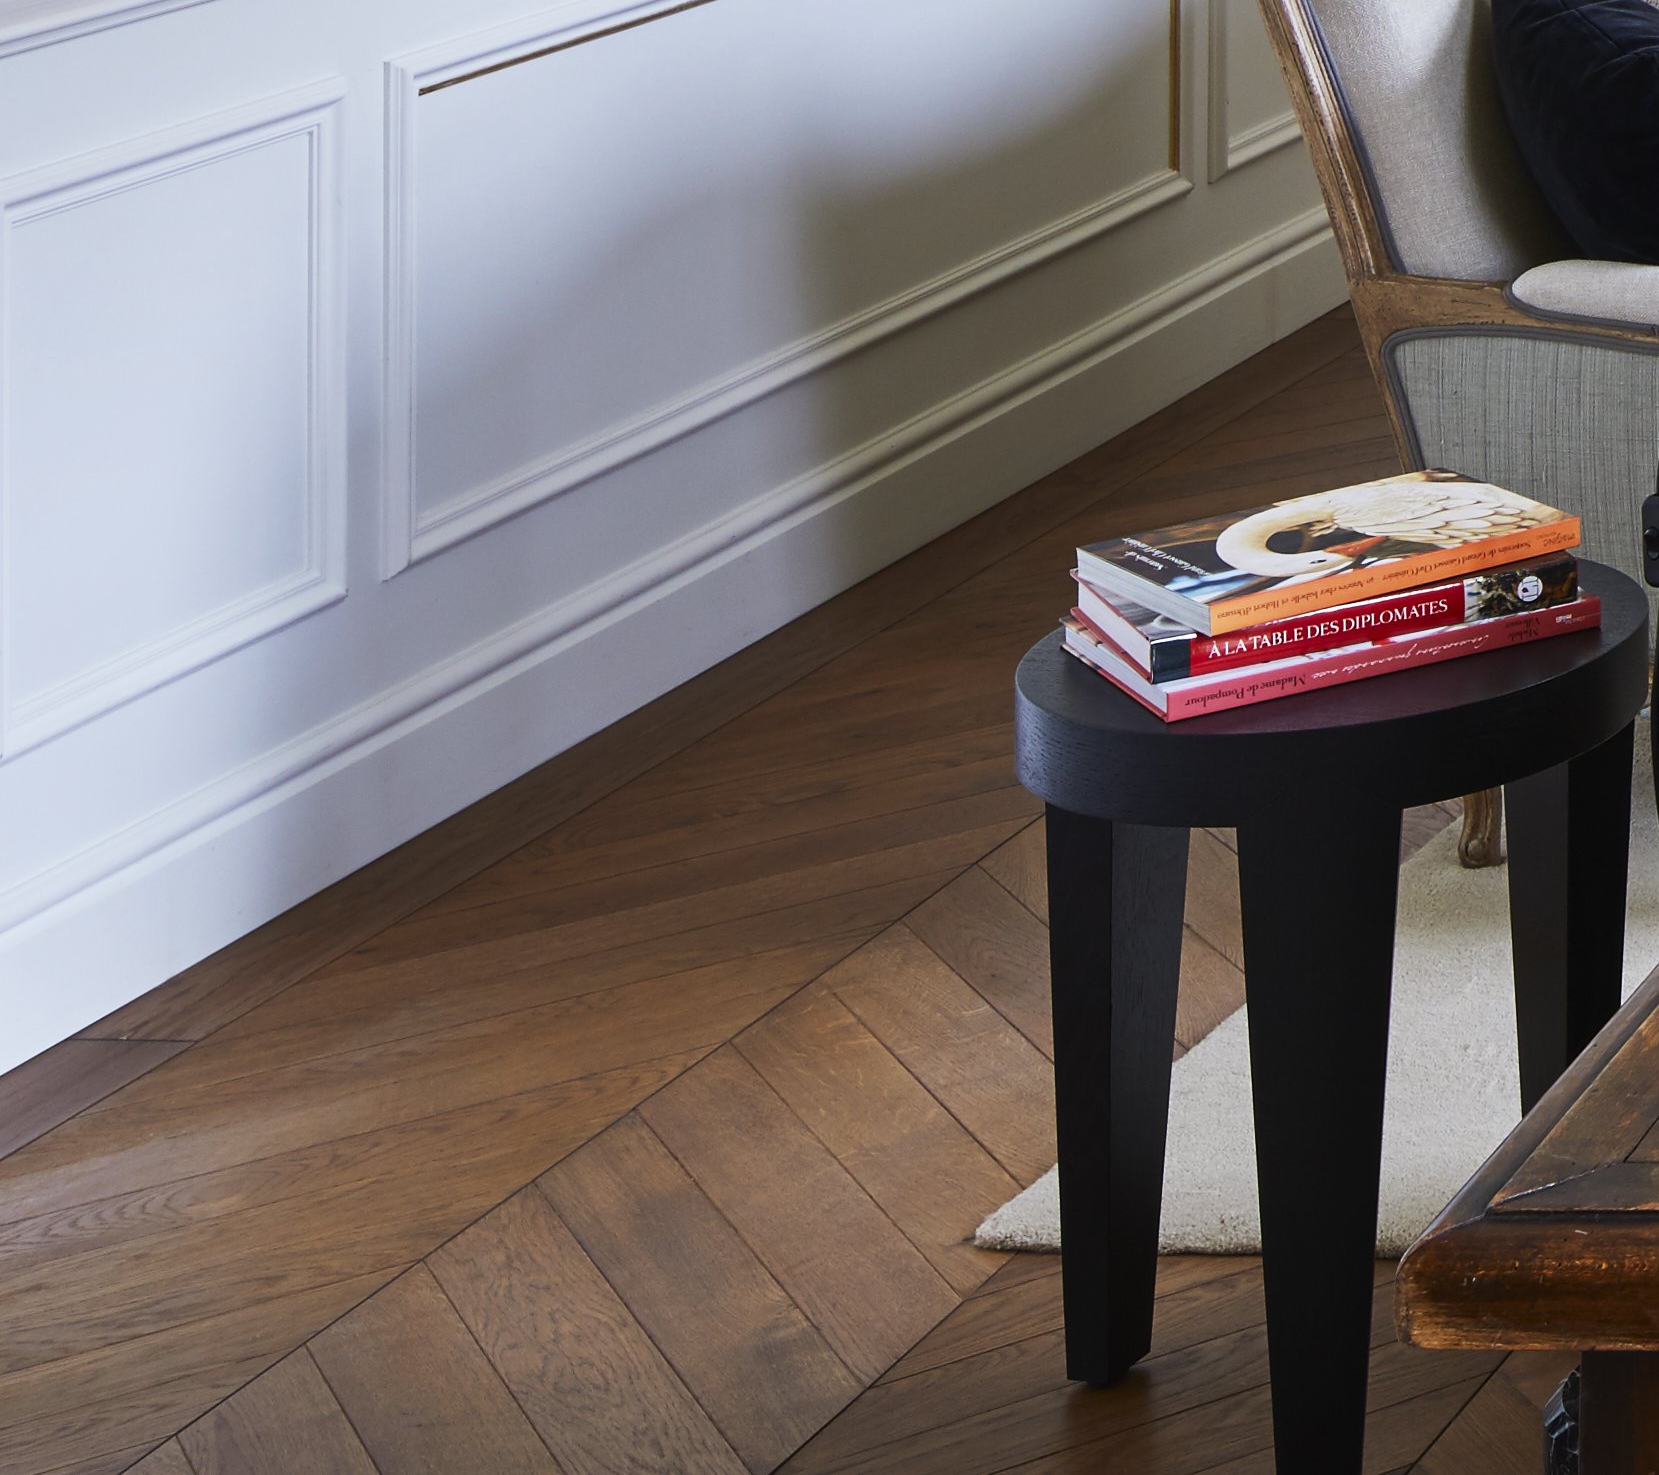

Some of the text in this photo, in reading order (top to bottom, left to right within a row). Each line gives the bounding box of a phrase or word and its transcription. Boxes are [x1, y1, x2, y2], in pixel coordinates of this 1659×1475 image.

[1208, 598, 1449, 659] À LA TABLE DES DIPLOMATES
[1185, 674, 1306, 708] Madame de Pompadour
